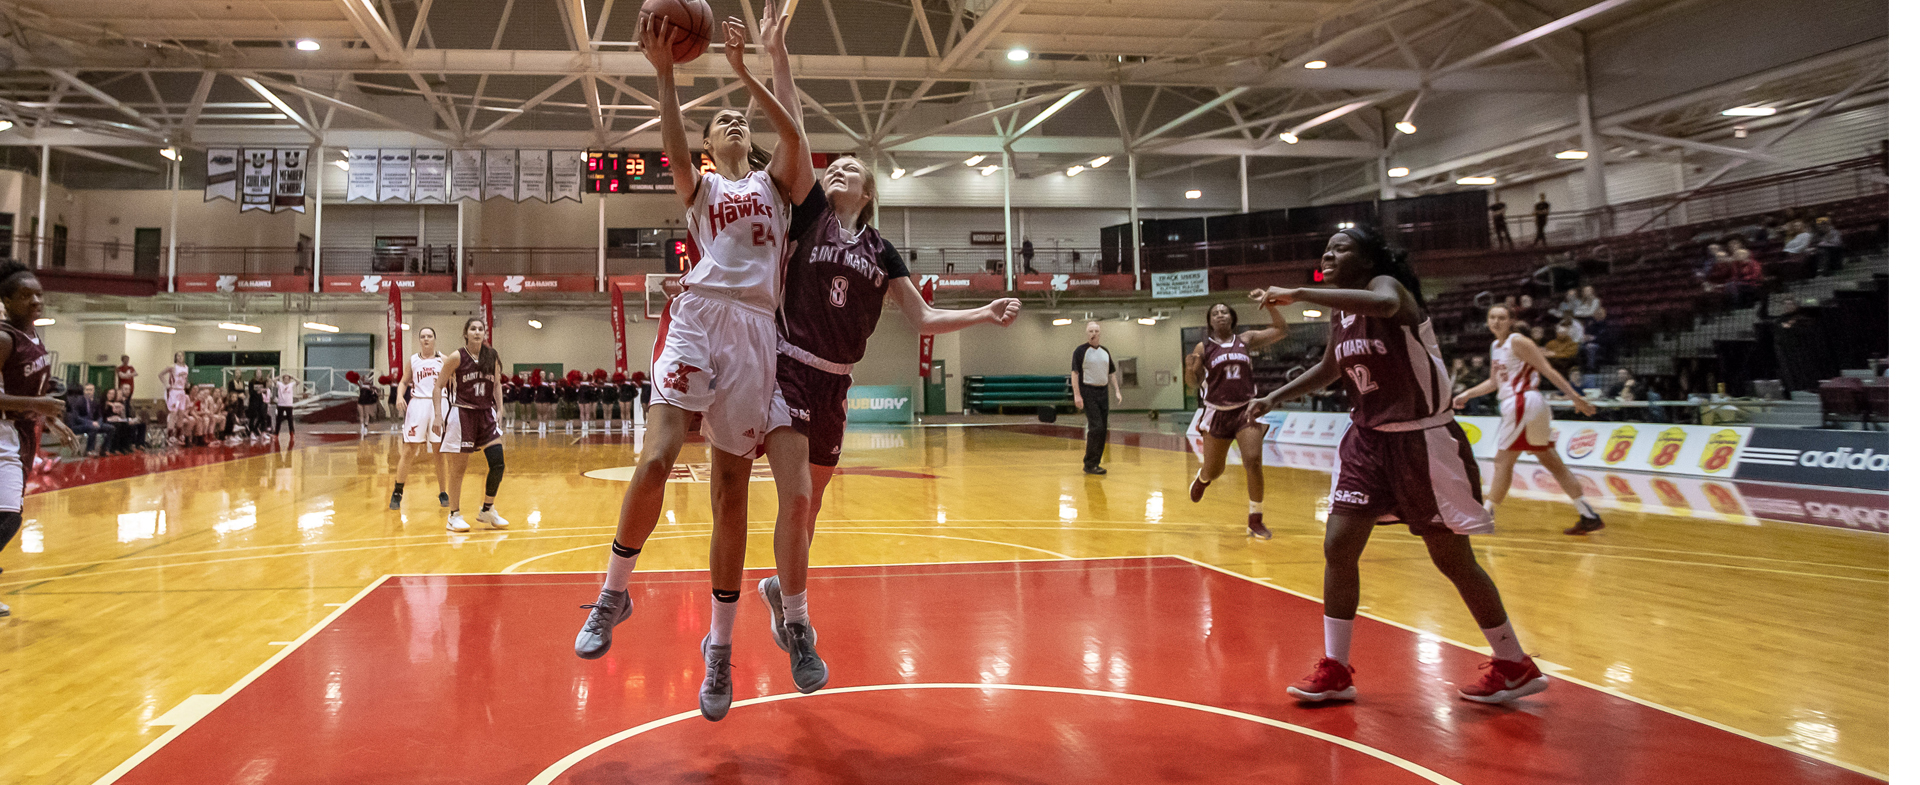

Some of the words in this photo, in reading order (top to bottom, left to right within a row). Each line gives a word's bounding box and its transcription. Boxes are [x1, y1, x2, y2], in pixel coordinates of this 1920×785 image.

[626, 159, 645, 175] 33
[708, 199, 773, 241] Hawks
[751, 222, 776, 247] 24
[809, 245, 841, 263] SINT
[829, 275, 849, 308] 8
[1343, 339, 1387, 357] MARY'S
[462, 371, 479, 384] SAINT
[1223, 364, 1242, 380] 12
[473, 382, 486, 397] 14
[1606, 440, 1632, 462] 8
[1653, 443, 1680, 466] 8
[1704, 446, 1735, 470] 8
[1800, 447, 1889, 472] adida
